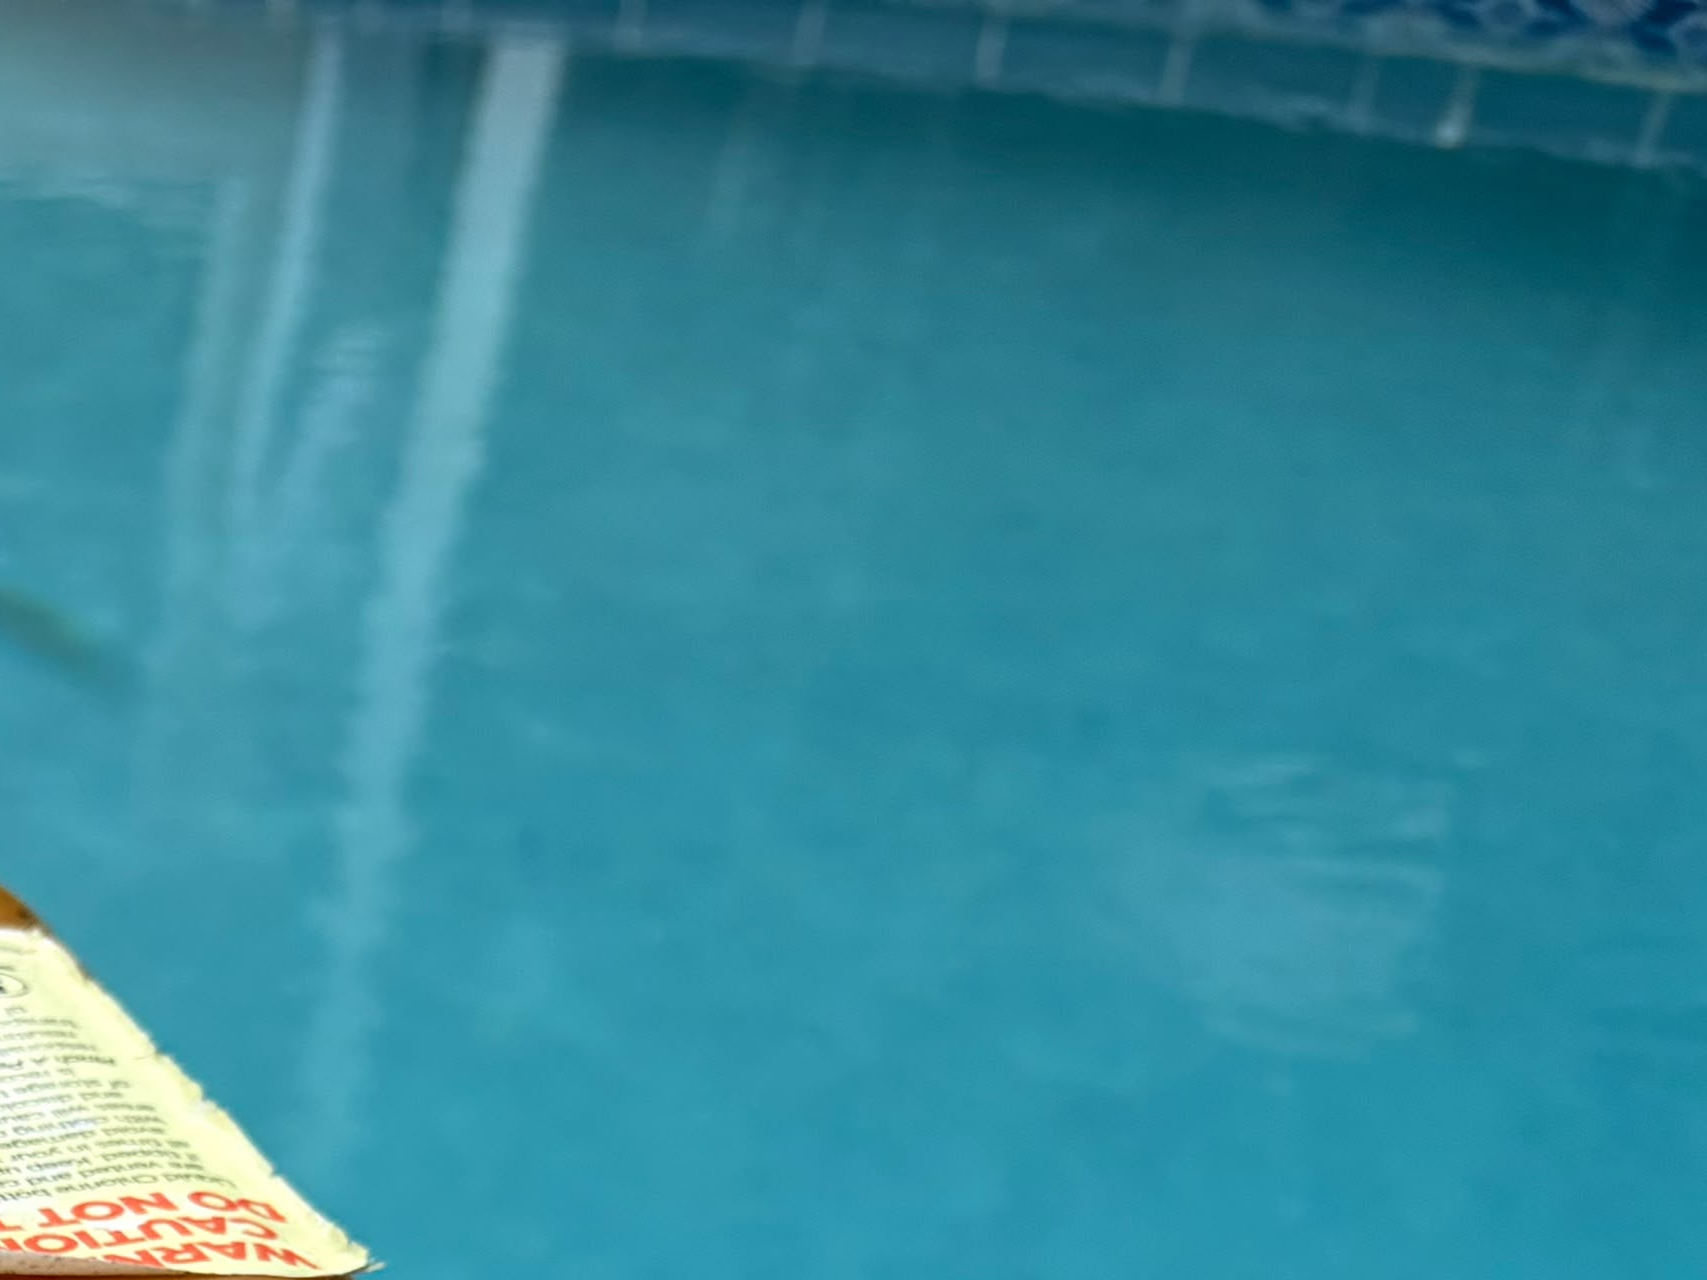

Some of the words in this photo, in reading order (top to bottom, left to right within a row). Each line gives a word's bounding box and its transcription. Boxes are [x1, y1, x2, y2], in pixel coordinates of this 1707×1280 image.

[31, 1057, 46, 1067] A
[50, 1105, 90, 1119] will
[14, 1116, 108, 1137] clothing
[67, 1144, 90, 1154] in
[96, 1139, 163, 1149] times
[10, 1148, 63, 1161] your
[28, 1157, 90, 1172] Keep
[79, 1162, 162, 1178] vented
[28, 1173, 72, 1185] and
[55, 1174, 158, 1194] Chlorine
[37, 1192, 179, 1228] NOT
[187, 1191, 286, 1224] DO
[100, 1241, 321, 1270] WARN
